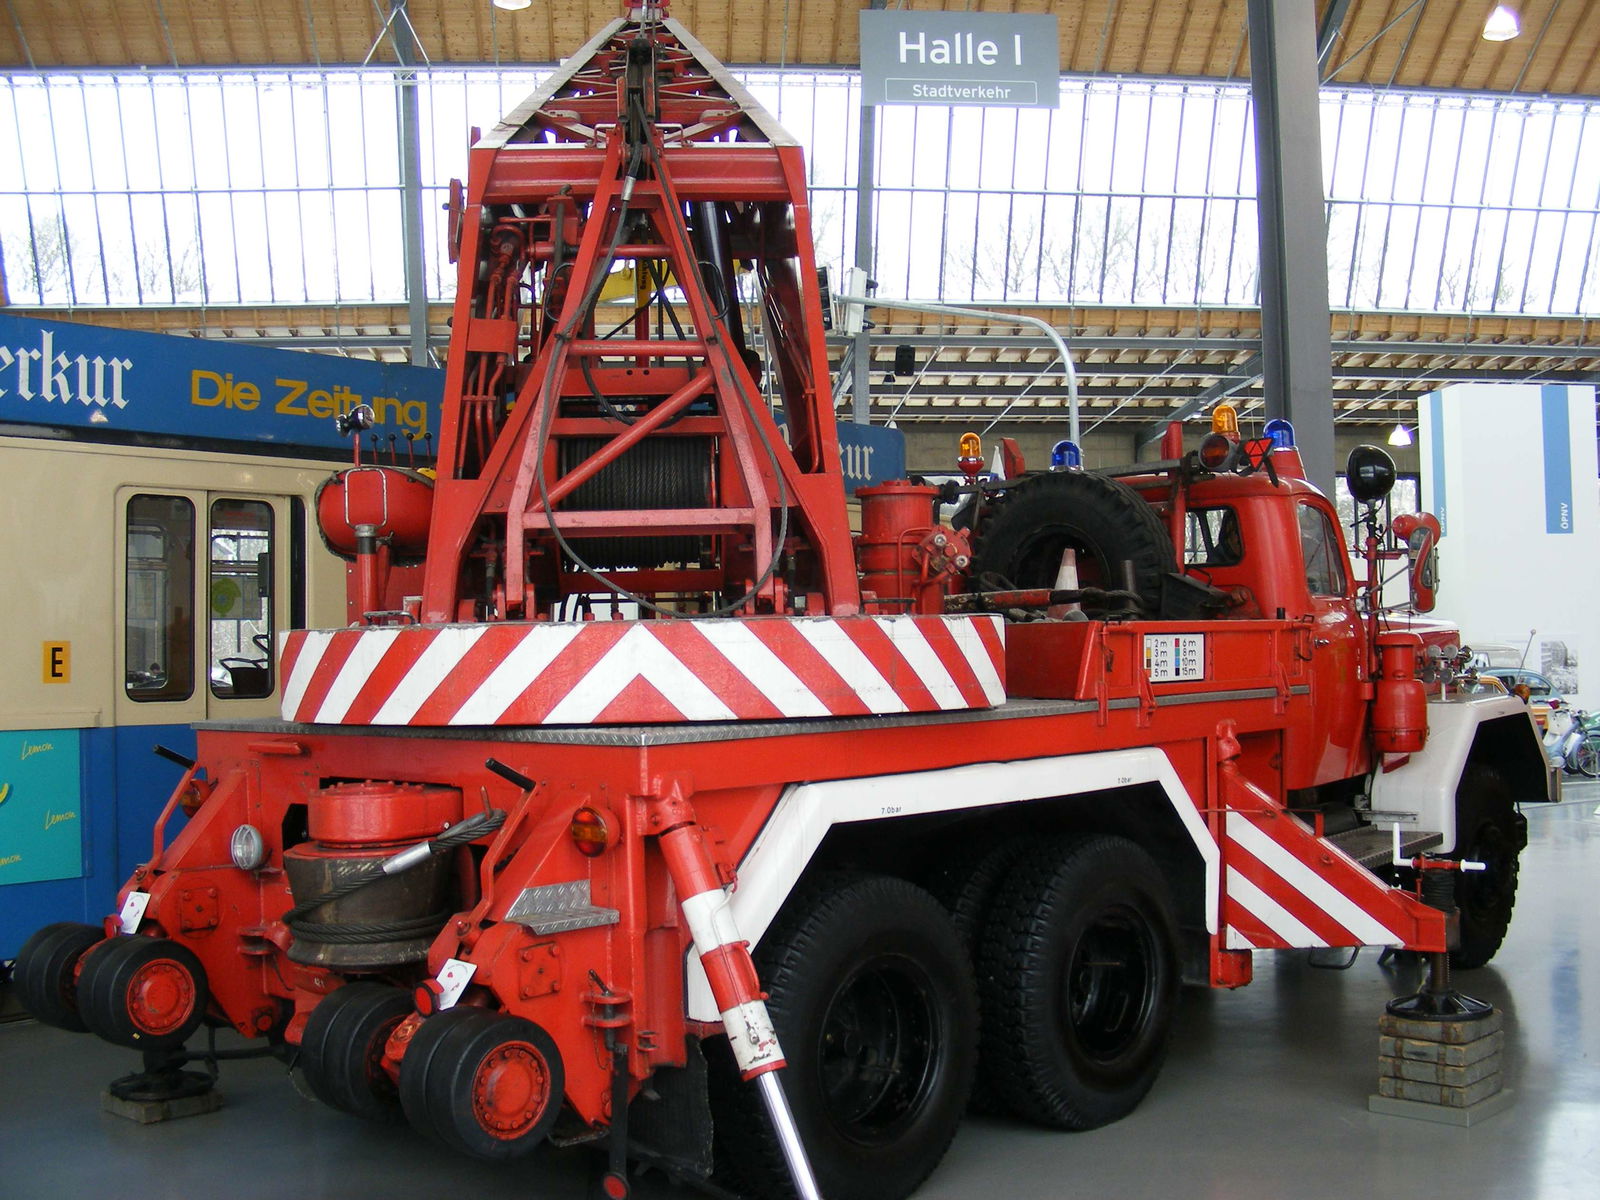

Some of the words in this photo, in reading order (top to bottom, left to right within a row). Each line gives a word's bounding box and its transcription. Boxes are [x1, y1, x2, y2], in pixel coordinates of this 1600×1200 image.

[900, 31, 999, 66] Halle
[912, 84, 1011, 99] Stadtverkehr
[191, 369, 261, 411] Die
[51, 647, 63, 678] E
[20, 740, 54, 760] Lemon
[44, 808, 77, 830] Lemon
